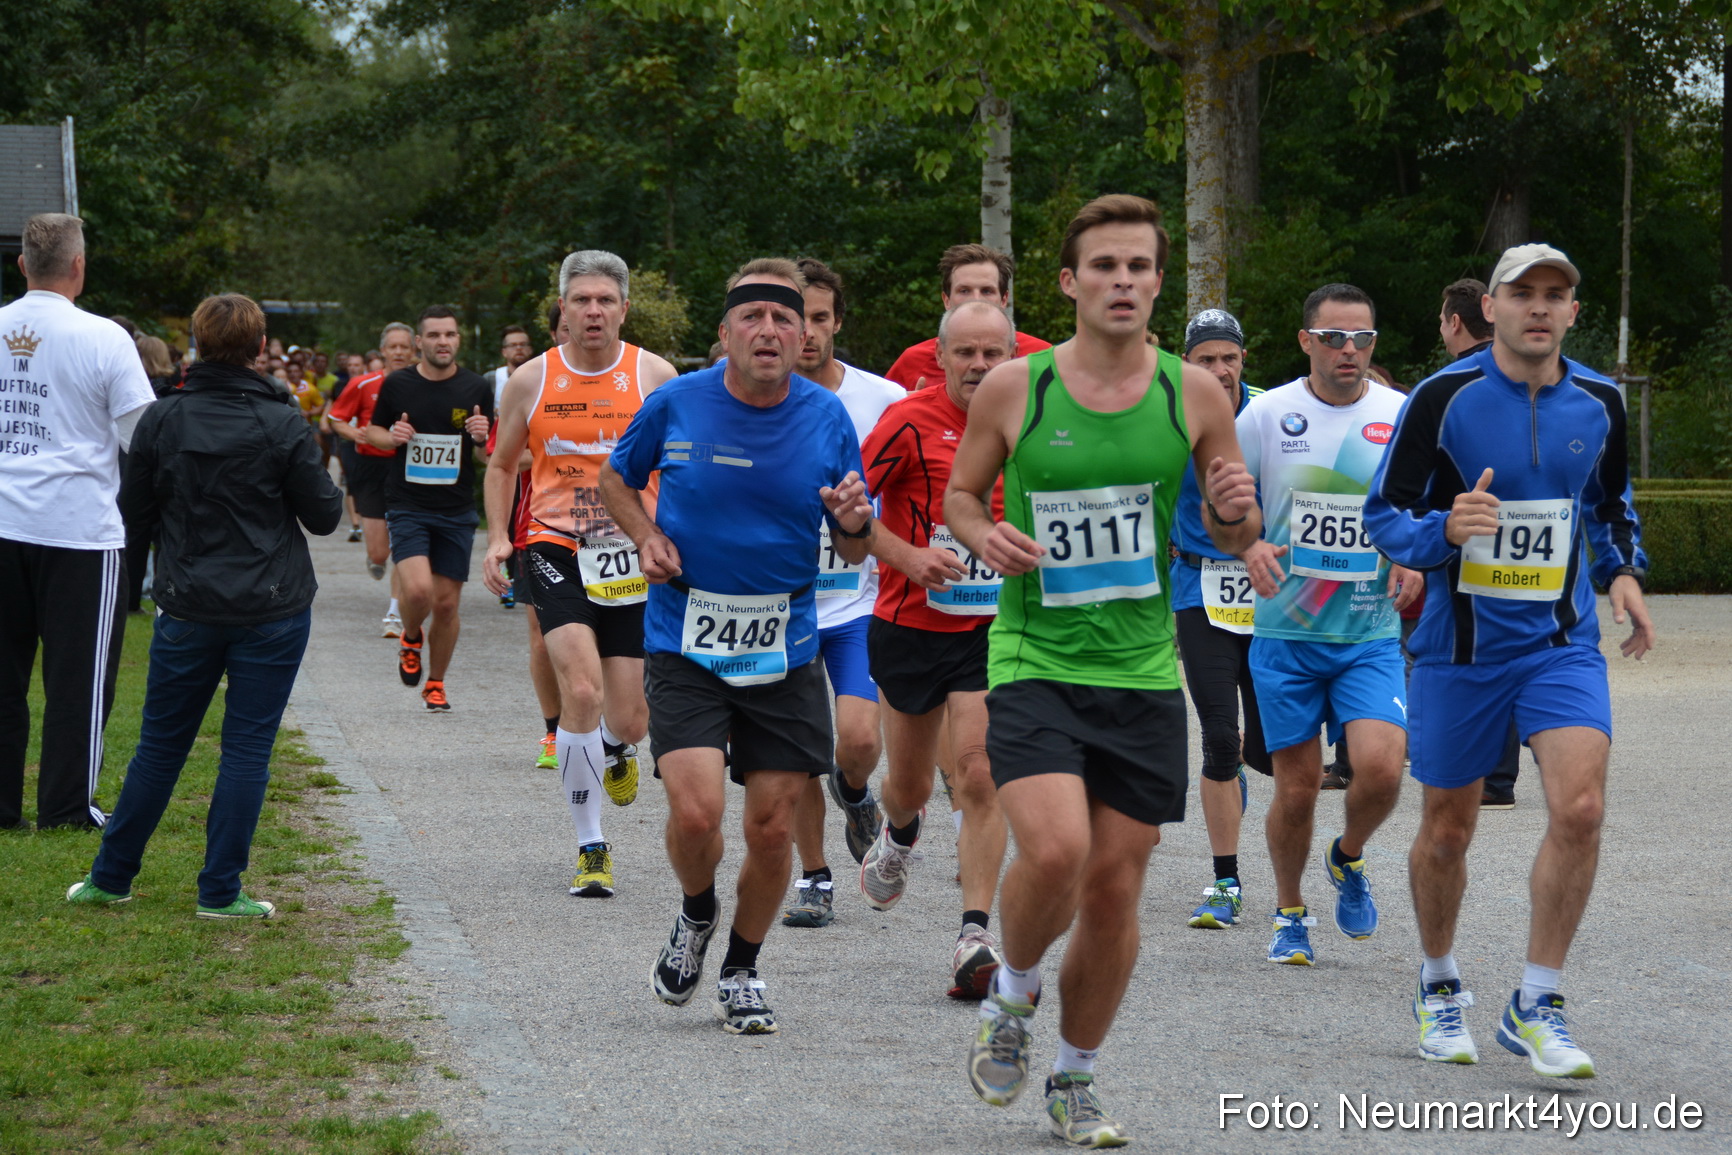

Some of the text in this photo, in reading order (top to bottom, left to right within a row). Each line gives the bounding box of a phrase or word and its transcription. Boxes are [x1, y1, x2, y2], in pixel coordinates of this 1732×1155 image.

[13, 358, 29, 373] IM
[0, 378, 48, 398] UFTRAG
[0, 420, 51, 441] JESTÄT:
[1281, 440, 1310, 449] PARTL
[412, 445, 456, 465] 3074
[1036, 497, 1131, 513] PARTL Neumarkt
[1295, 499, 1364, 513] PARTL Neumar
[570, 507, 589, 519] FOR
[1507, 511, 1557, 520] Neumarkt
[933, 533, 954, 543] PAR
[1048, 511, 1142, 561] 3117
[1204, 564, 1232, 572] PARTL
[1321, 555, 1349, 569] Rico
[1492, 570, 1541, 586] Robert
[953, 589, 999, 602] Herbert
[690, 597, 775, 614] PARTL Neumarkt
[694, 615, 781, 651] 2448
[710, 658, 759, 675] Werner
